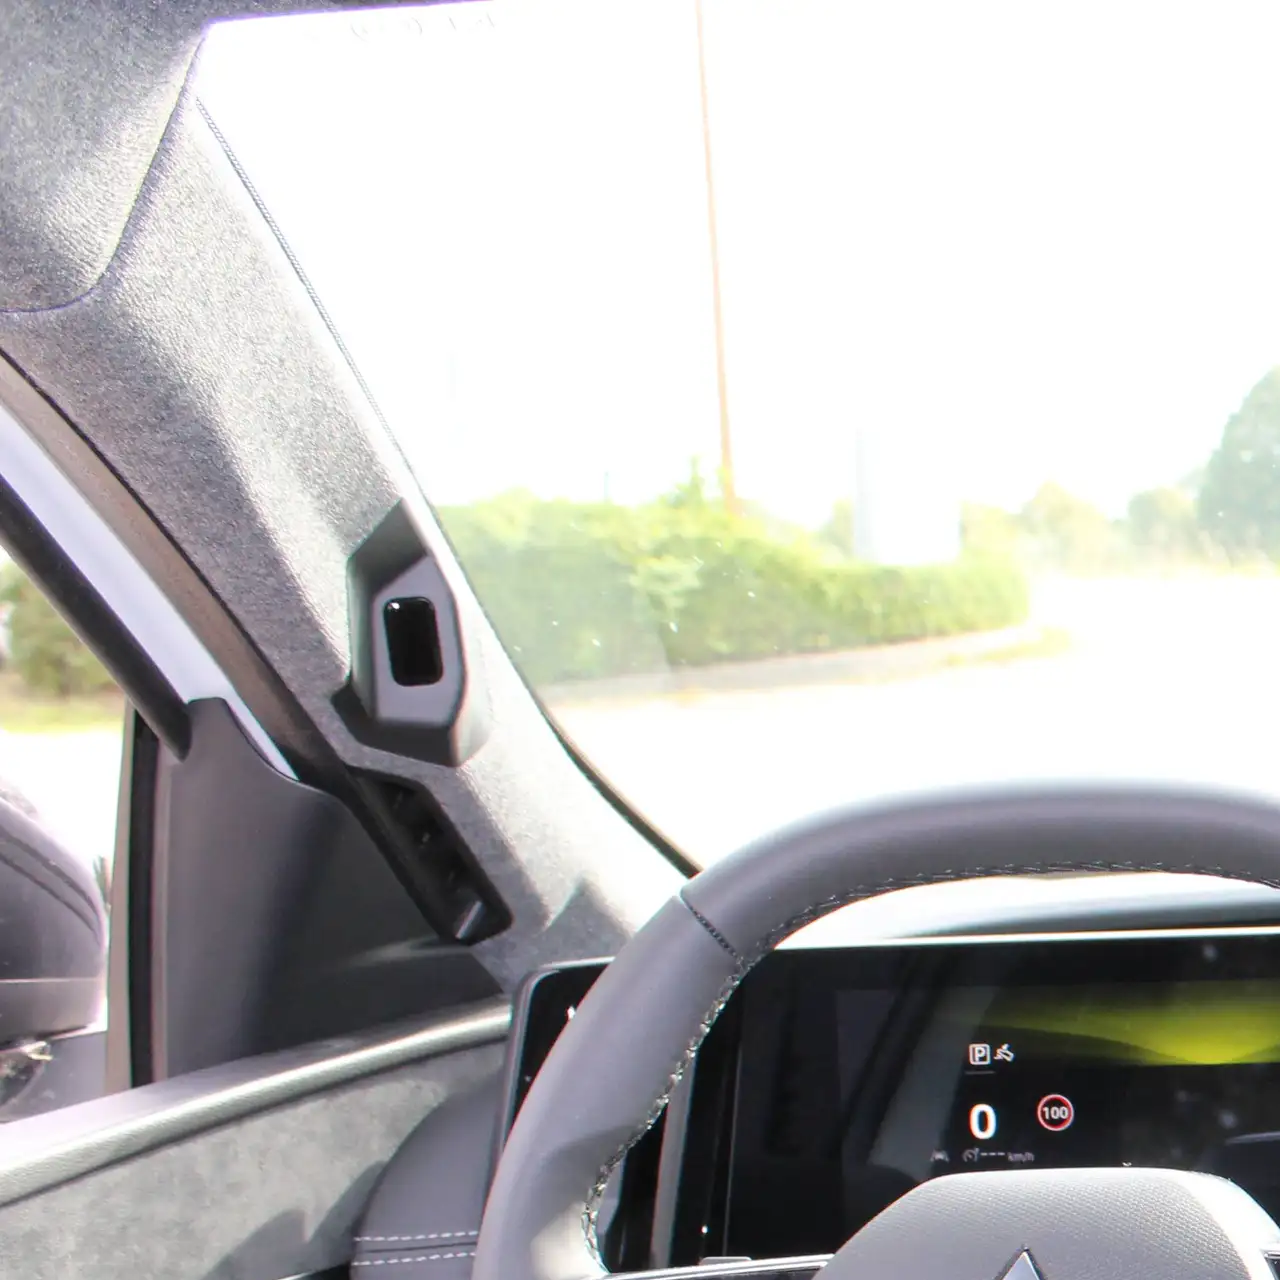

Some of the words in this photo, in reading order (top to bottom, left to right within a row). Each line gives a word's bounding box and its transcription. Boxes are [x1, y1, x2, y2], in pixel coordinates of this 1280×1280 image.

[1042, 1106, 1069, 1120] 100
[969, 1103, 997, 1140] 0
[1007, 1151, 1035, 1163] km/h
